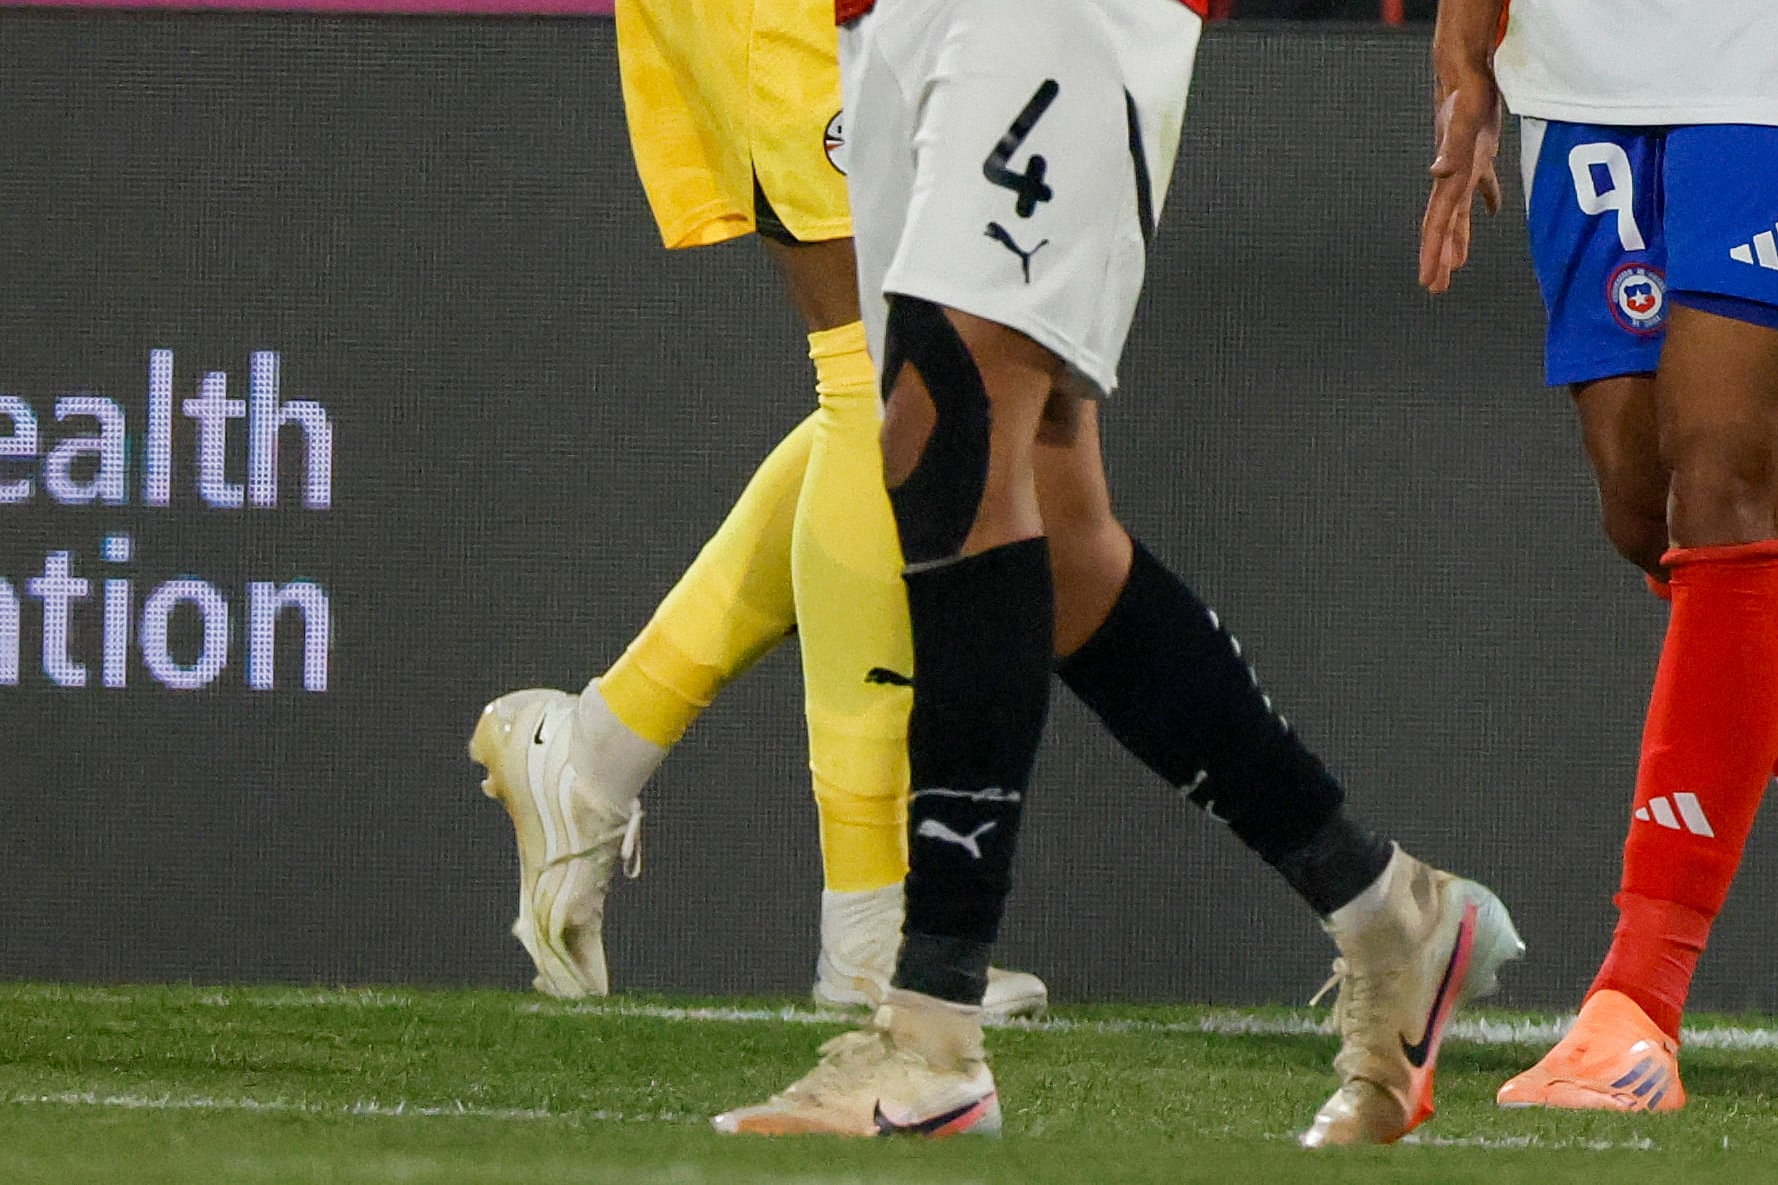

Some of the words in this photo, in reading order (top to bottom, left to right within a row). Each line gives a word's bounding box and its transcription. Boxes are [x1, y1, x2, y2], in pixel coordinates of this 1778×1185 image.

[983, 78, 1056, 218] 4
[1569, 142, 1646, 252] 9
[0, 536, 329, 691] tion
